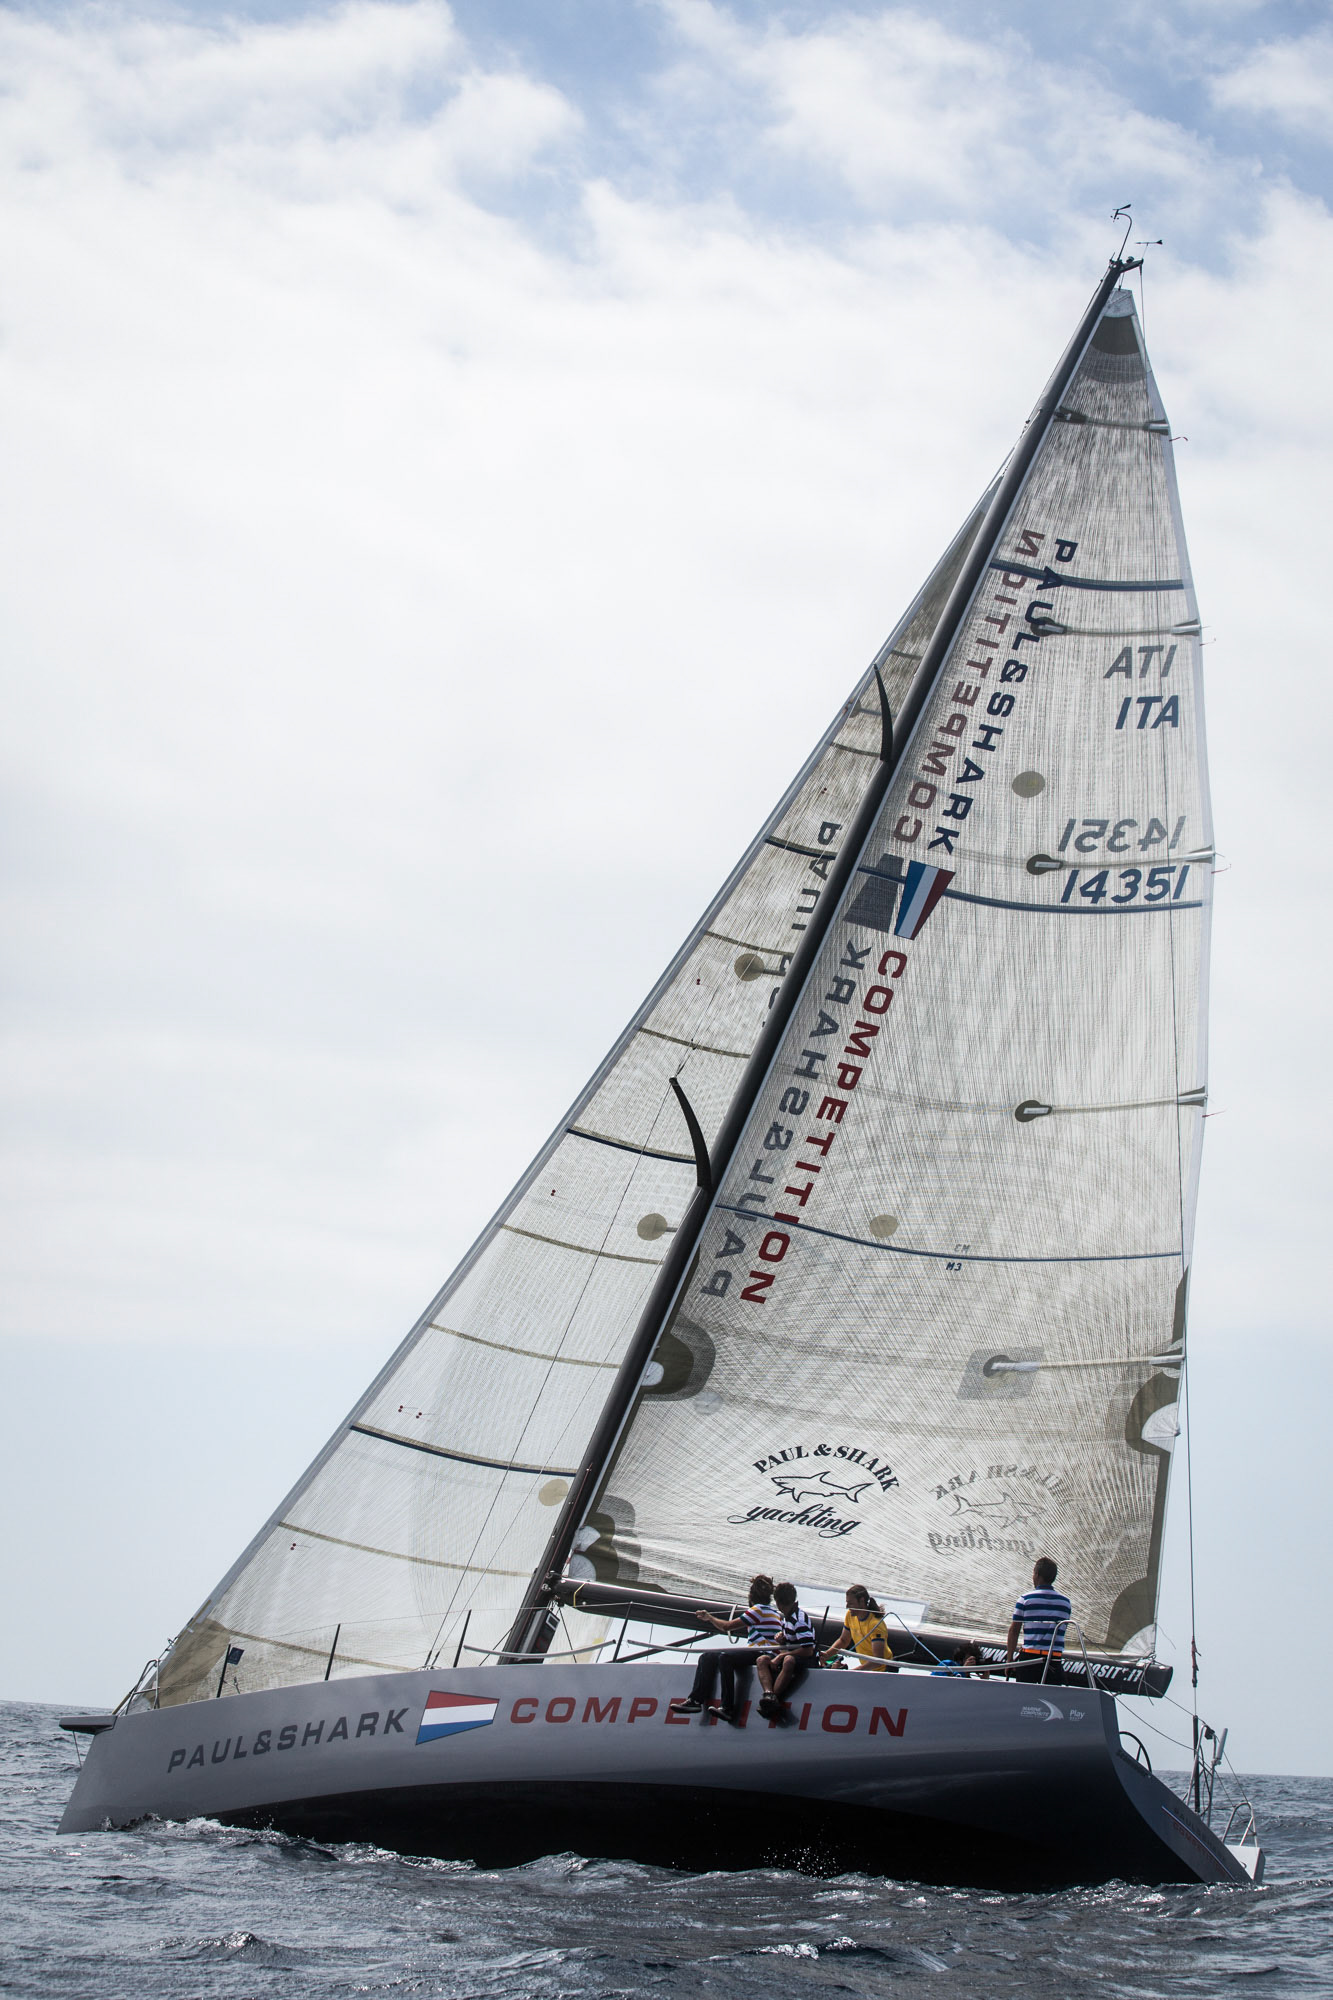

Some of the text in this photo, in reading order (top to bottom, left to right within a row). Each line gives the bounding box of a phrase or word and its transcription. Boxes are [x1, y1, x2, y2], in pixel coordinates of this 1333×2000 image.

[927, 538, 1079, 856] PAUL&SHARK
[1114, 694, 1180, 730] ITA
[1060, 864, 1191, 905] 14351
[741, 949, 908, 1304] COMPETITION
[751, 1442, 901, 1493] PAUL & SHARK
[726, 1503, 863, 1539] yachting
[166, 1706, 411, 1774] PAUL&SHARK
